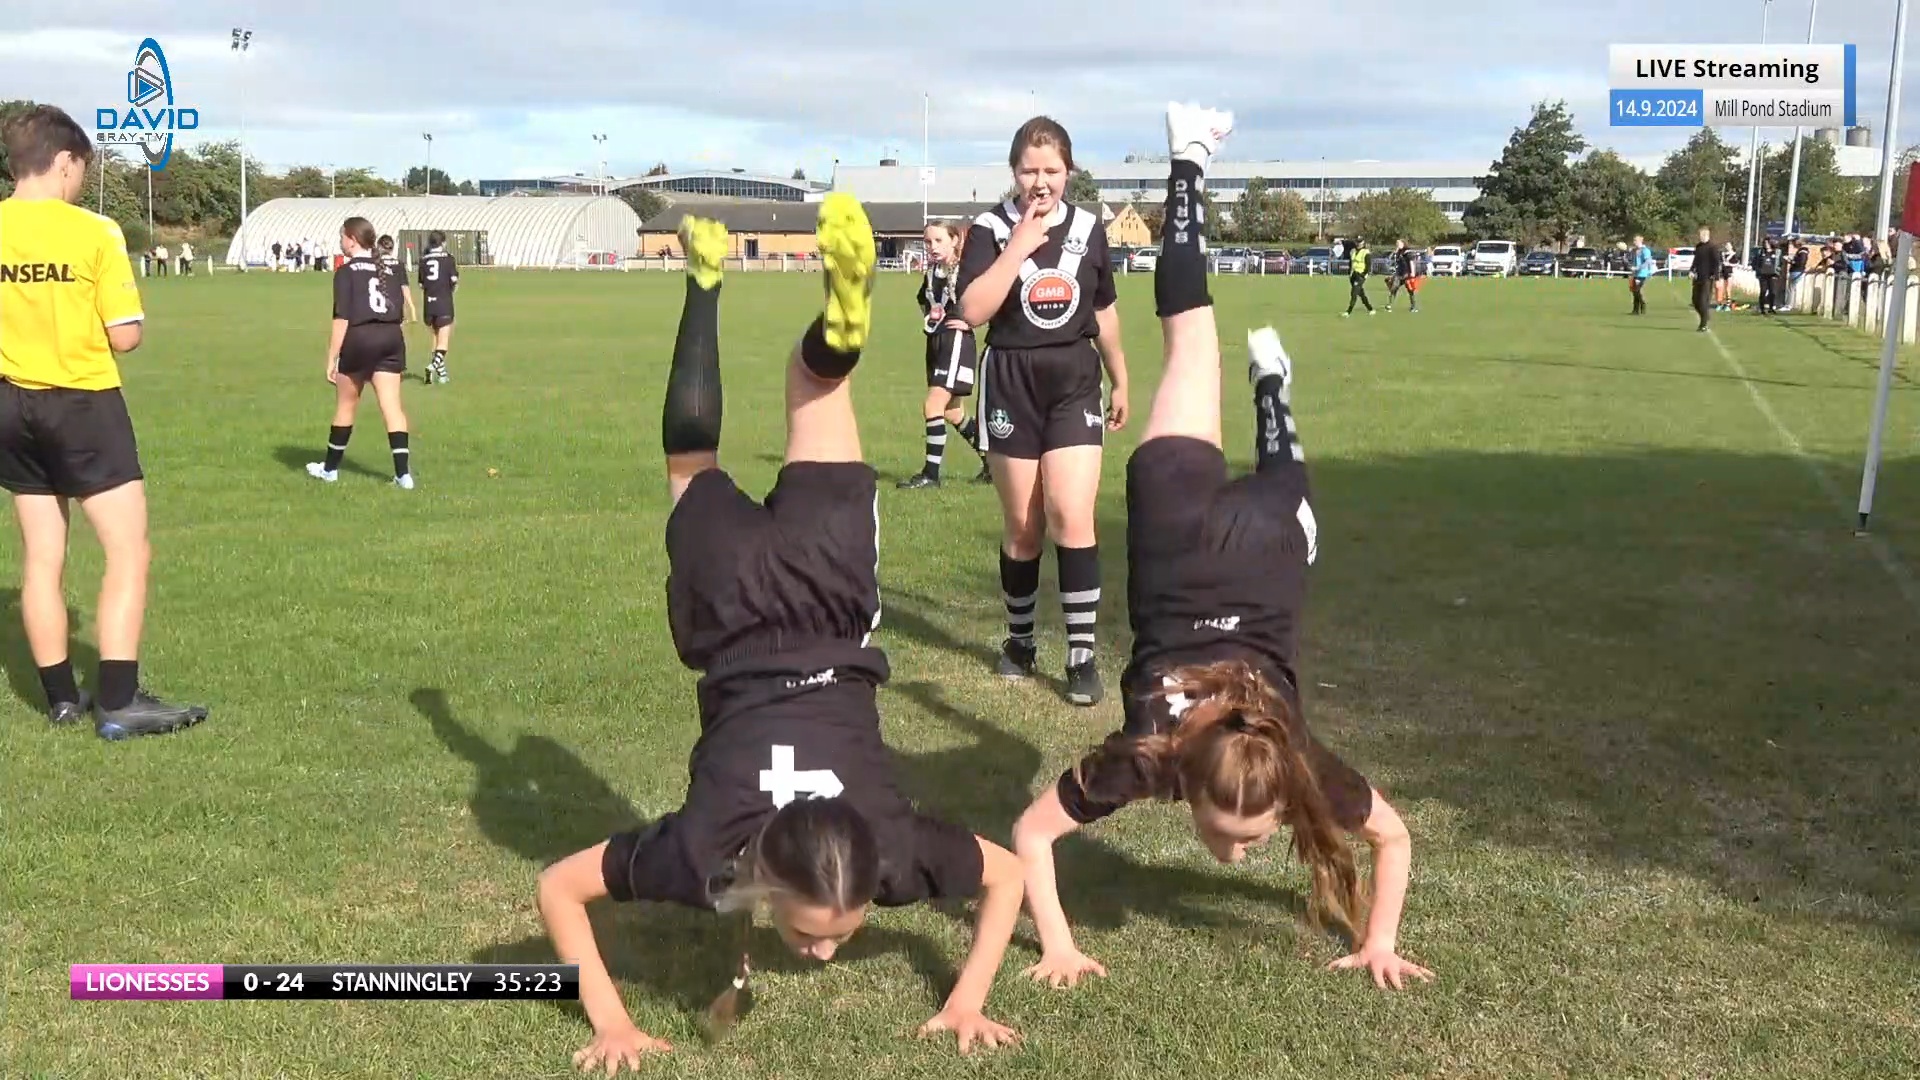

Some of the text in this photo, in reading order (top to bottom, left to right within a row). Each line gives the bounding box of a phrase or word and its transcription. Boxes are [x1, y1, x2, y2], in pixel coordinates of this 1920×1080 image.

[0, 264, 76, 283] NSEAL
[426, 259, 440, 281] 3
[1035, 286, 1065, 298] GMB
[1036, 302, 1065, 311] UNION
